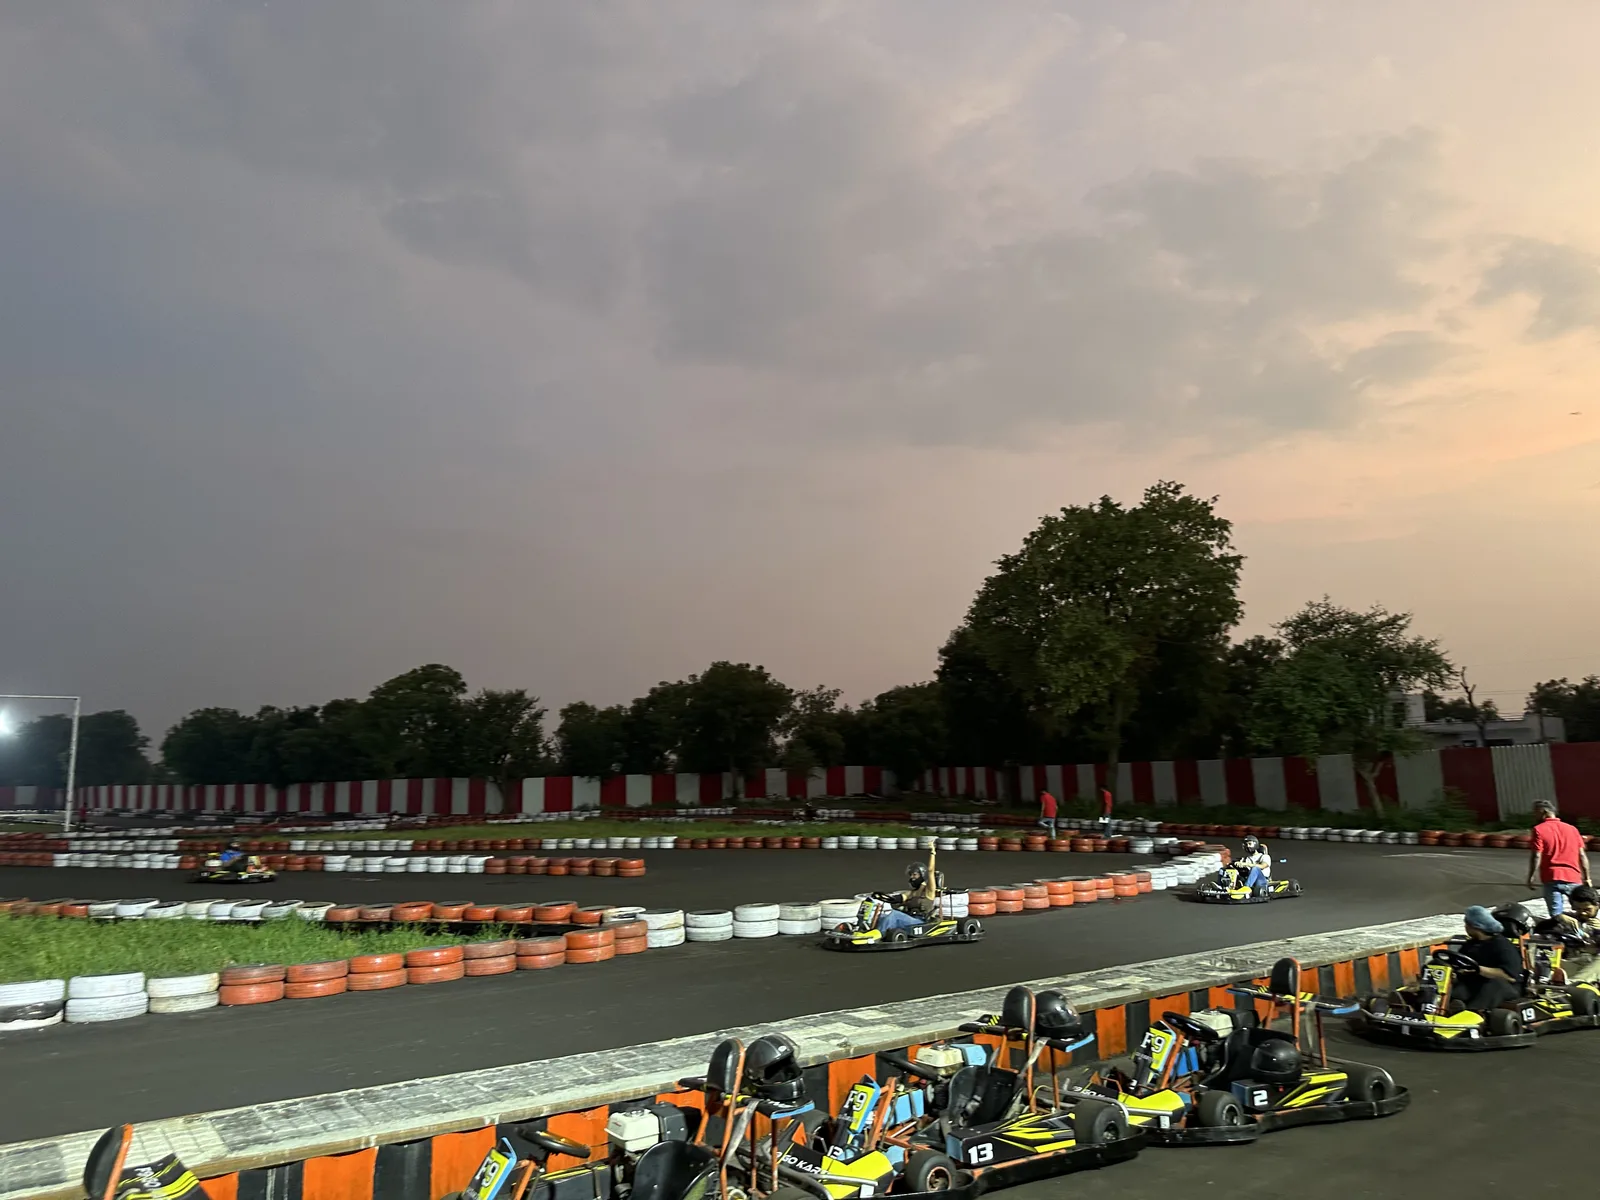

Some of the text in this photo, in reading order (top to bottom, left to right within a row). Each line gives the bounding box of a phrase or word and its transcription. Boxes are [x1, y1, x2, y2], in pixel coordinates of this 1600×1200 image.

[913, 927, 923, 935] 11
[1422, 968, 1444, 982] F9
[1521, 1008, 1535, 1021] 19
[1140, 1032, 1165, 1053] F9
[843, 1090, 867, 1111] F9
[1253, 1090, 1268, 1106] 2
[782, 1154, 799, 1165] GO
[827, 1145, 844, 1159] 13
[968, 1142, 994, 1164] 13
[475, 1156, 500, 1187] F9
